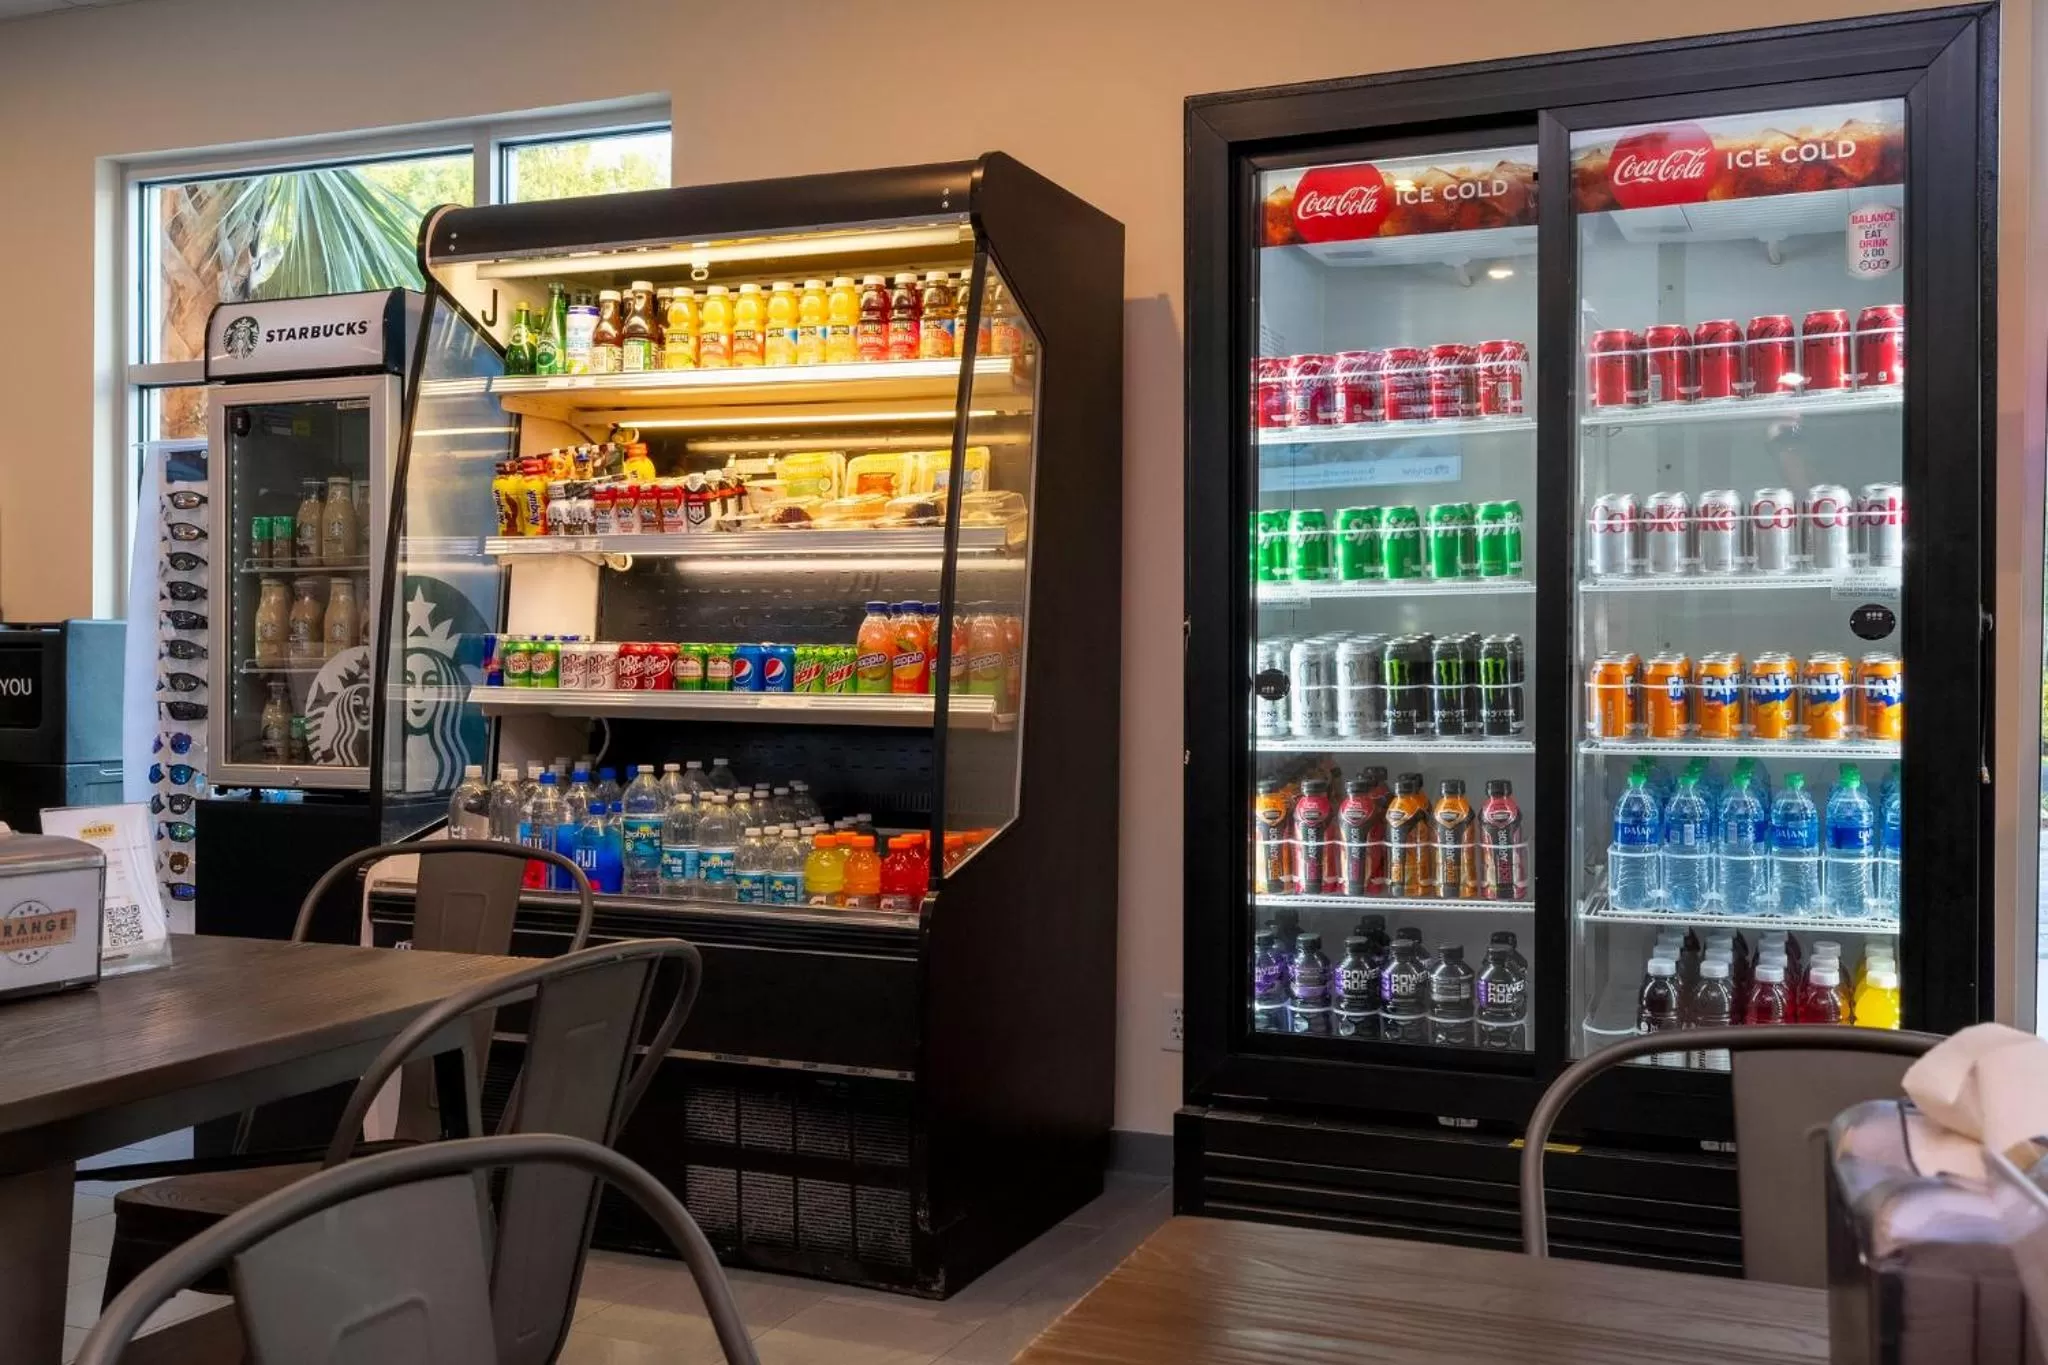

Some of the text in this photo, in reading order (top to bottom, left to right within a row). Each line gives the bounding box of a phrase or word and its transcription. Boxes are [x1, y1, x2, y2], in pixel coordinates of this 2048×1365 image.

[1727, 140, 1857, 170] ICE COLD
[1613, 147, 1710, 186] Coca-Cola
[1297, 183, 1381, 220] Coca-Cola
[1396, 179, 1509, 206] ICE COLD
[1852, 212, 1896, 225] BALANCE
[1859, 238, 1888, 249] DRINK
[1865, 229, 1883, 240] EAT
[265, 320, 368, 344] STARBUCKS
[0, 677, 33, 696] YOU
[575, 848, 598, 868] FIJI
